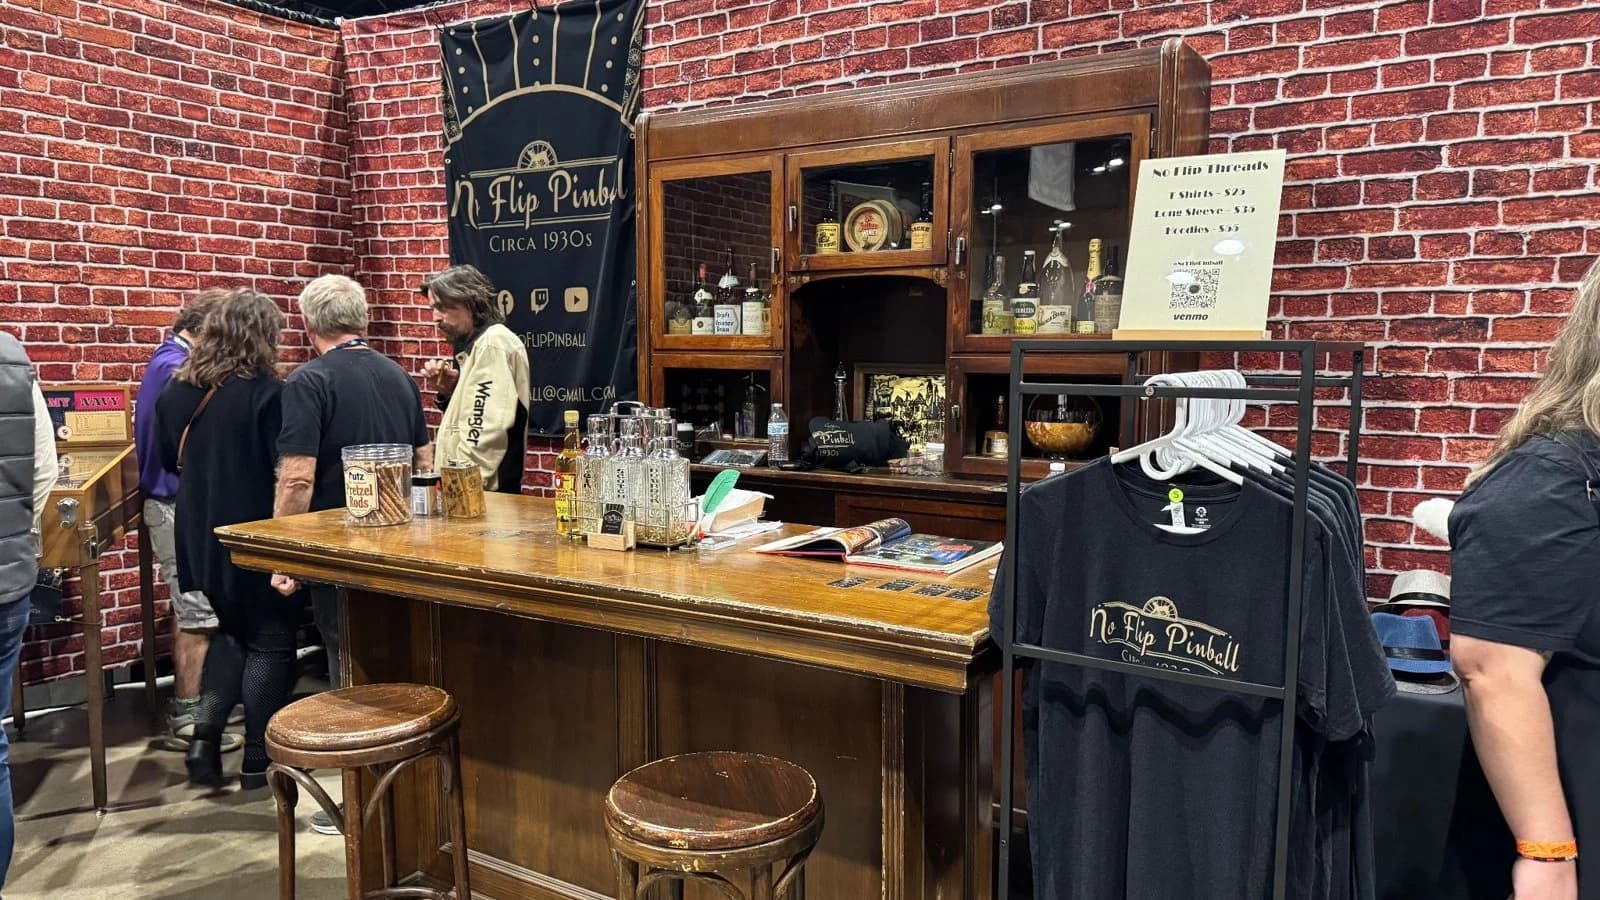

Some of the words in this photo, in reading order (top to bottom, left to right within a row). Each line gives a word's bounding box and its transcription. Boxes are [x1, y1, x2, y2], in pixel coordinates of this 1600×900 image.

[1152, 168, 1170, 178] No
[1173, 165, 1202, 177] Flip
[1207, 160, 1269, 174] Threads
[1179, 189, 1213, 199] Shirts
[1224, 187, 1246, 198] $25
[489, 175, 540, 230] Flip
[1154, 209, 1183, 219] Long
[1185, 207, 1223, 217] Sleeve
[1233, 204, 1256, 215] $35
[1165, 224, 1210, 236] Hoodies
[1218, 223, 1240, 233] $55
[1173, 313, 1209, 321] venmo
[79, 396, 120, 408] NAVY
[467, 380, 493, 447] Wrangler
[819, 432, 856, 446] Pinball
[1089, 604, 1117, 645] No
[1123, 611, 1157, 657] Flip
[1165, 622, 1240, 673] Pinball
